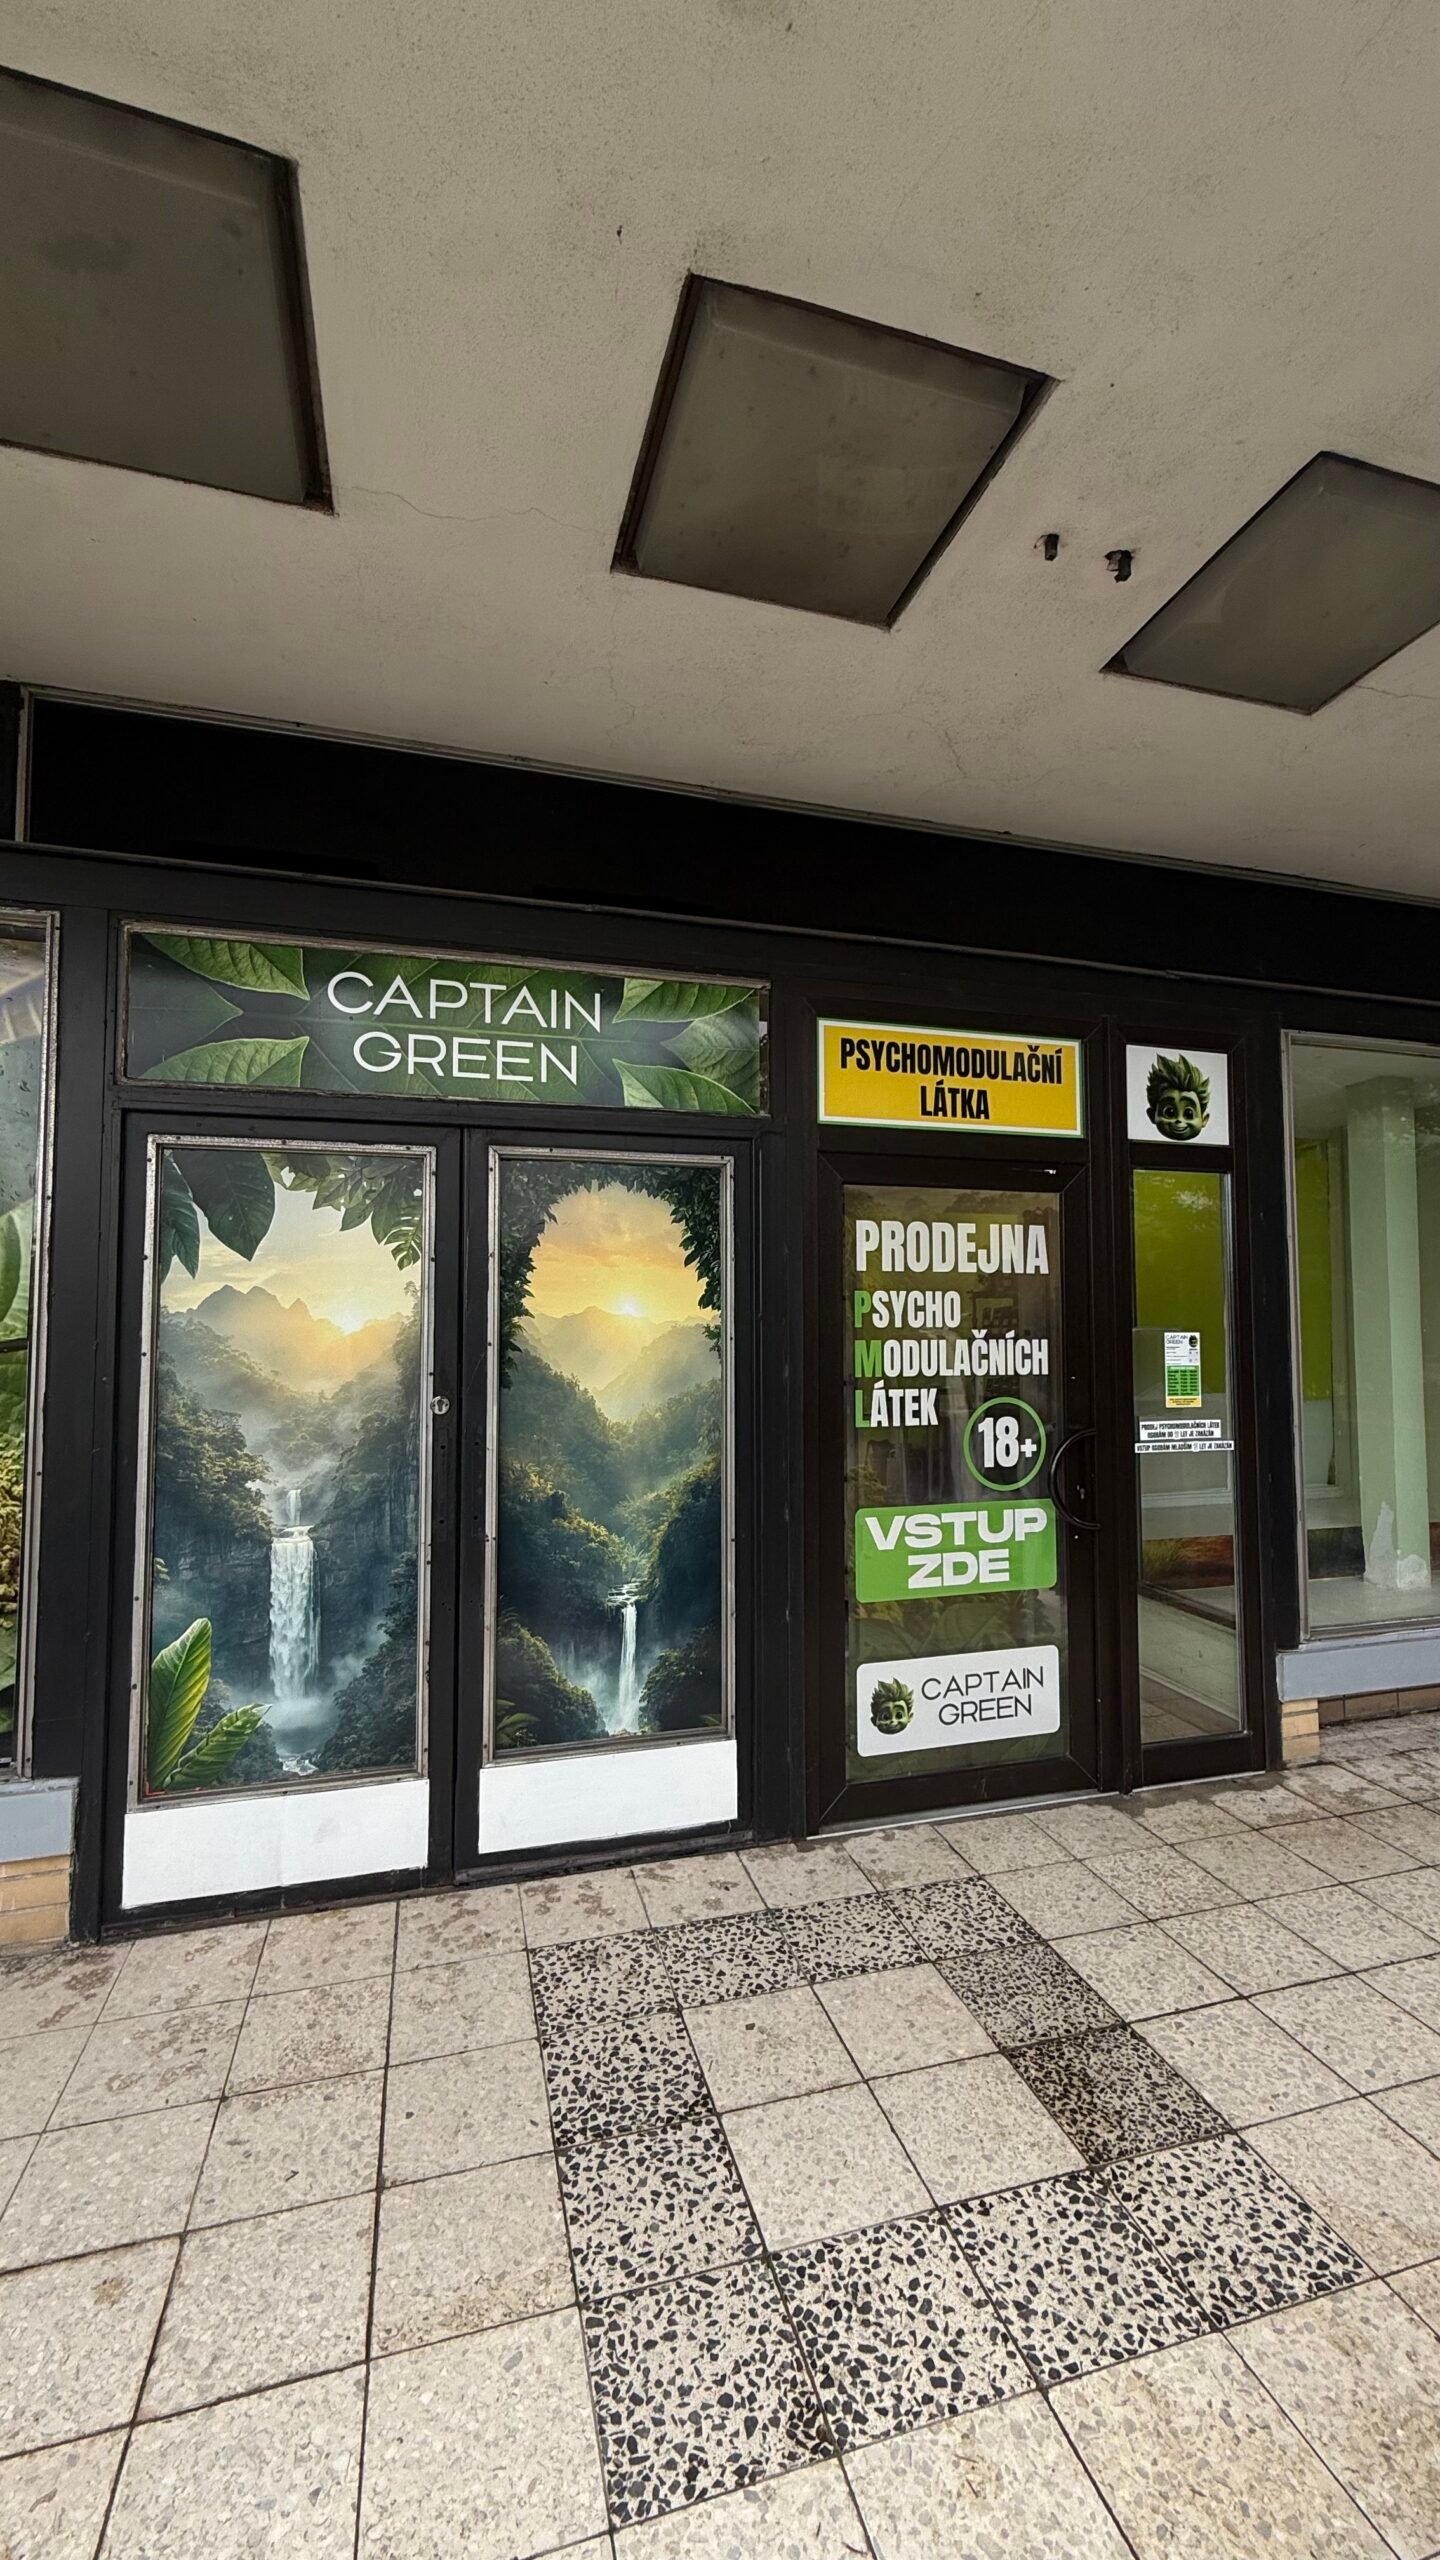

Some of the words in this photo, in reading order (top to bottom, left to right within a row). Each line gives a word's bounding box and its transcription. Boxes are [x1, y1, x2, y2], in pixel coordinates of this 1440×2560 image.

[327, 970, 601, 1033] CAPTAIN
[353, 1030, 578, 1086] GREEN
[840, 1037, 1063, 1085] PSYCHOMODULAČNÍ
[920, 1080, 990, 1120] LÁTKA
[855, 1219, 1049, 1275] PRODEJNA
[853, 1290, 961, 1328] PSYCHO
[854, 1329, 1049, 1377] MODULAČNÍCH
[854, 1380, 939, 1428] LÁTEK
[977, 1415, 1038, 1468] 18+
[865, 1507, 1047, 1550] VSTUP
[907, 1550, 1010, 1589] ZDE
[921, 1666, 1044, 1701] CAPTAIN
[938, 1693, 1032, 1727] GREEN
